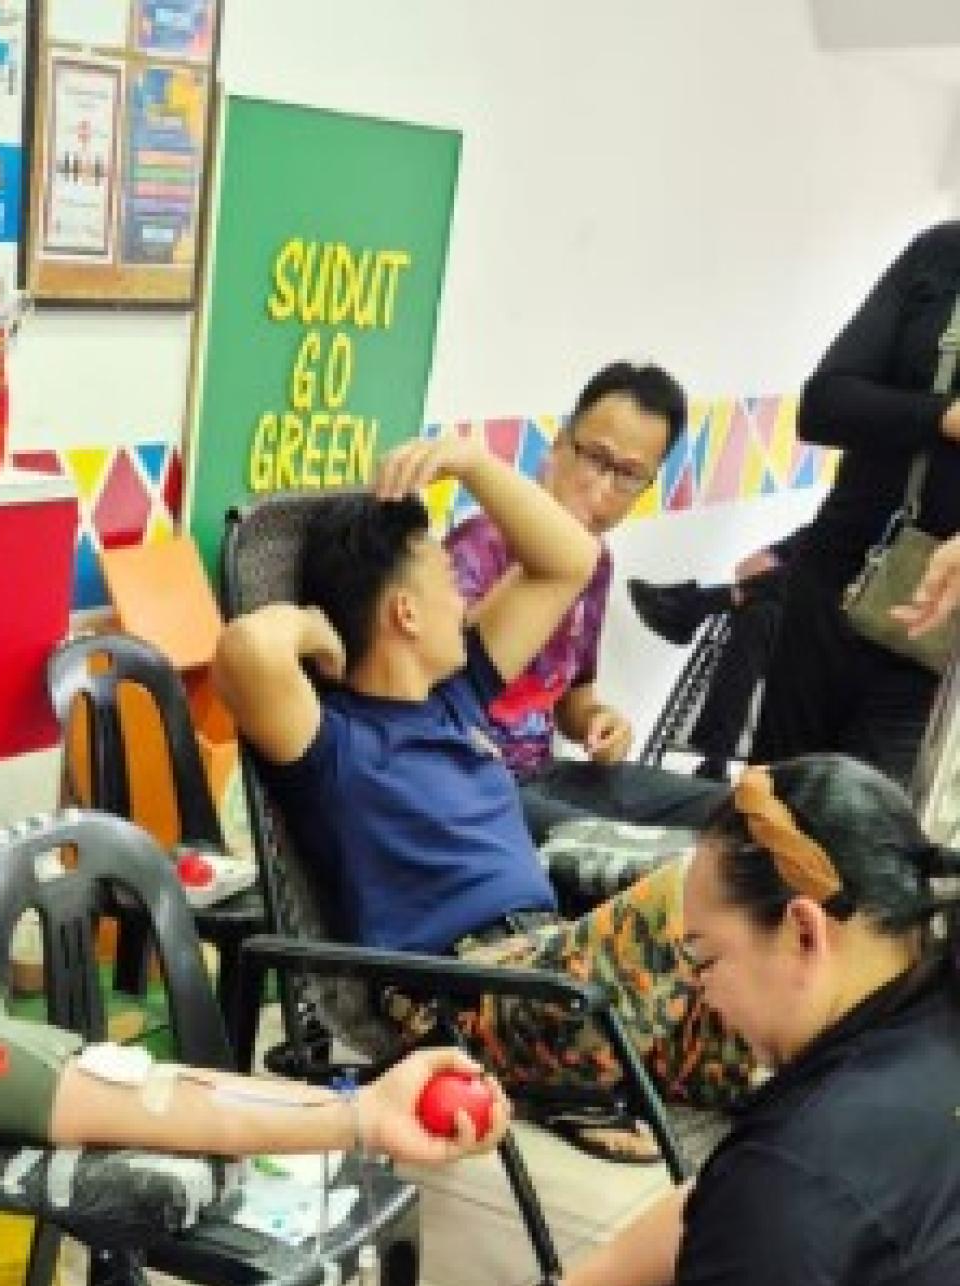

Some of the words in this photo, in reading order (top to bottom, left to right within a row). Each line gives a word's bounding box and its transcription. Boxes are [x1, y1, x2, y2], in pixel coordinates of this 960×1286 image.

[267, 237, 411, 328] SUDUT
[292, 330, 354, 412] GO
[249, 411, 380, 491] GREEN
